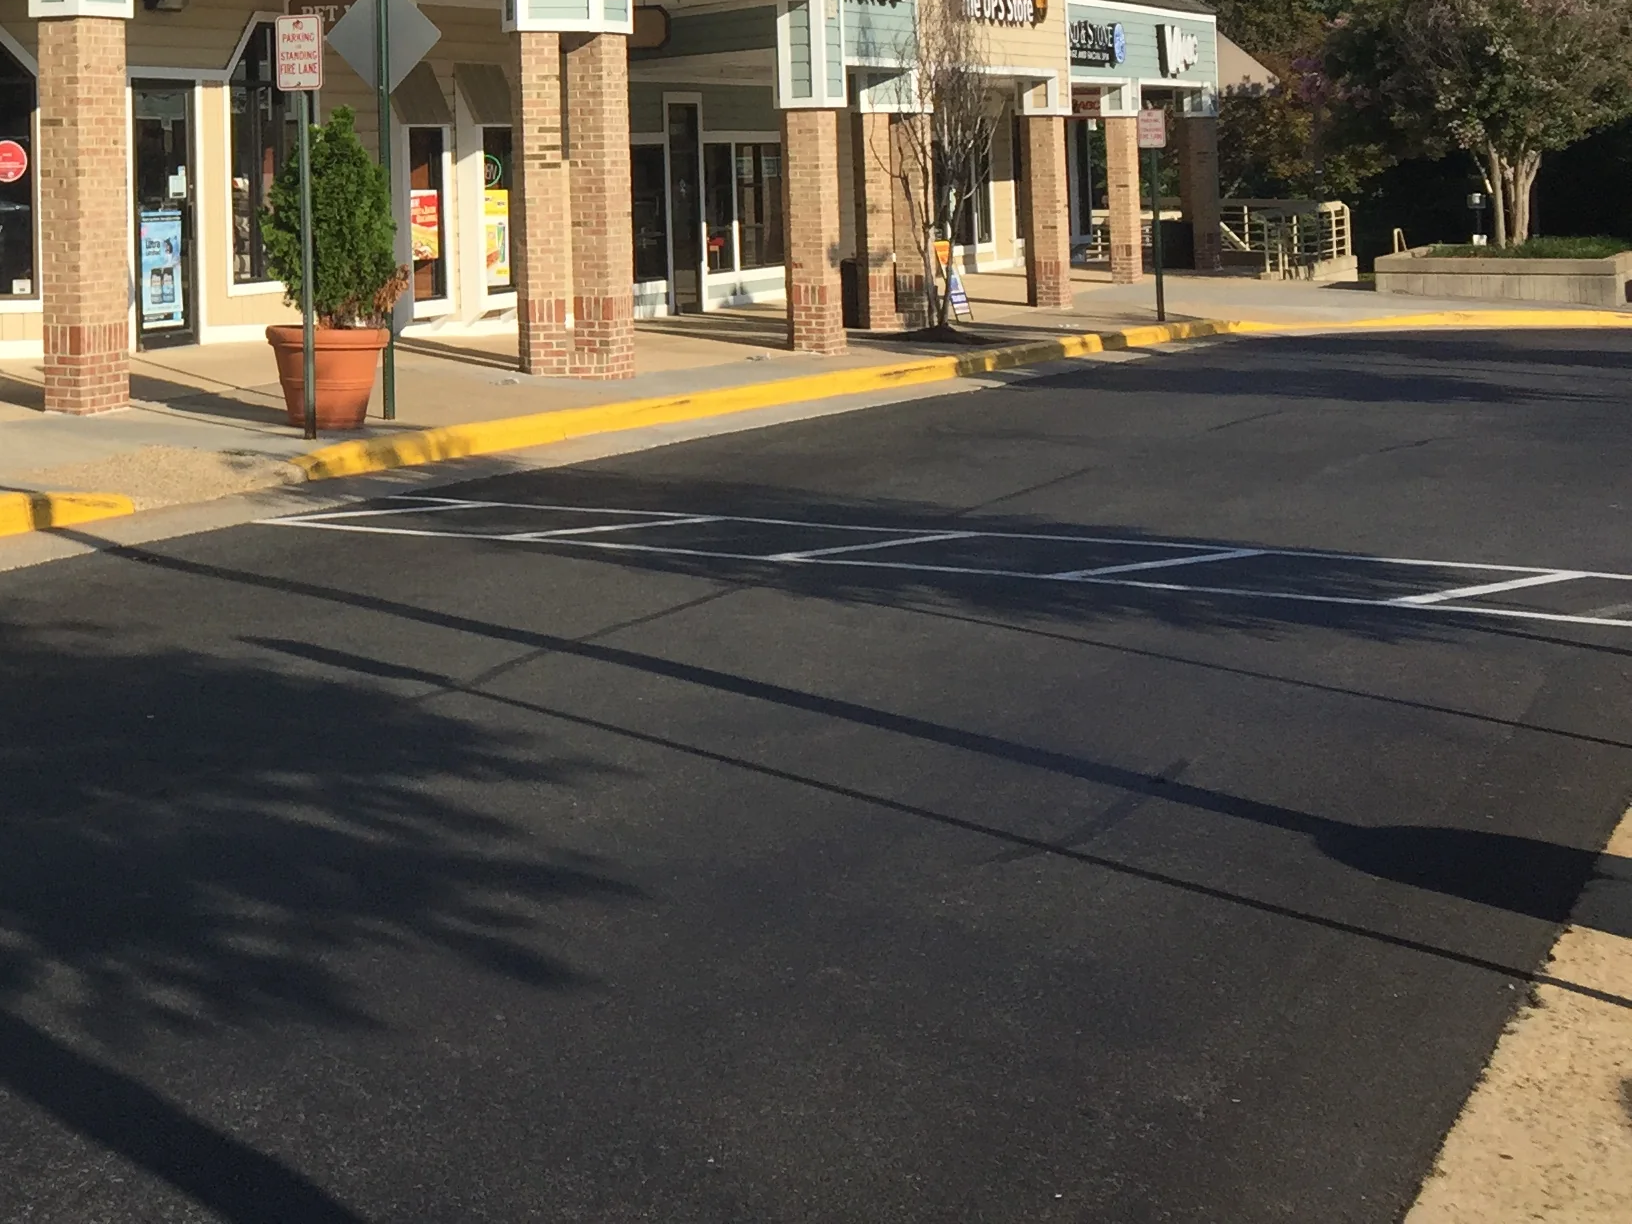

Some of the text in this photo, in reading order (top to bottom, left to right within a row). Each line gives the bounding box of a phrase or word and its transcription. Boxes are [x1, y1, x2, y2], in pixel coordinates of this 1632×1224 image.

[282, 32, 315, 43] PARKING
[280, 50, 317, 61] STANDING
[280, 63, 318, 75] FIRE LANE
